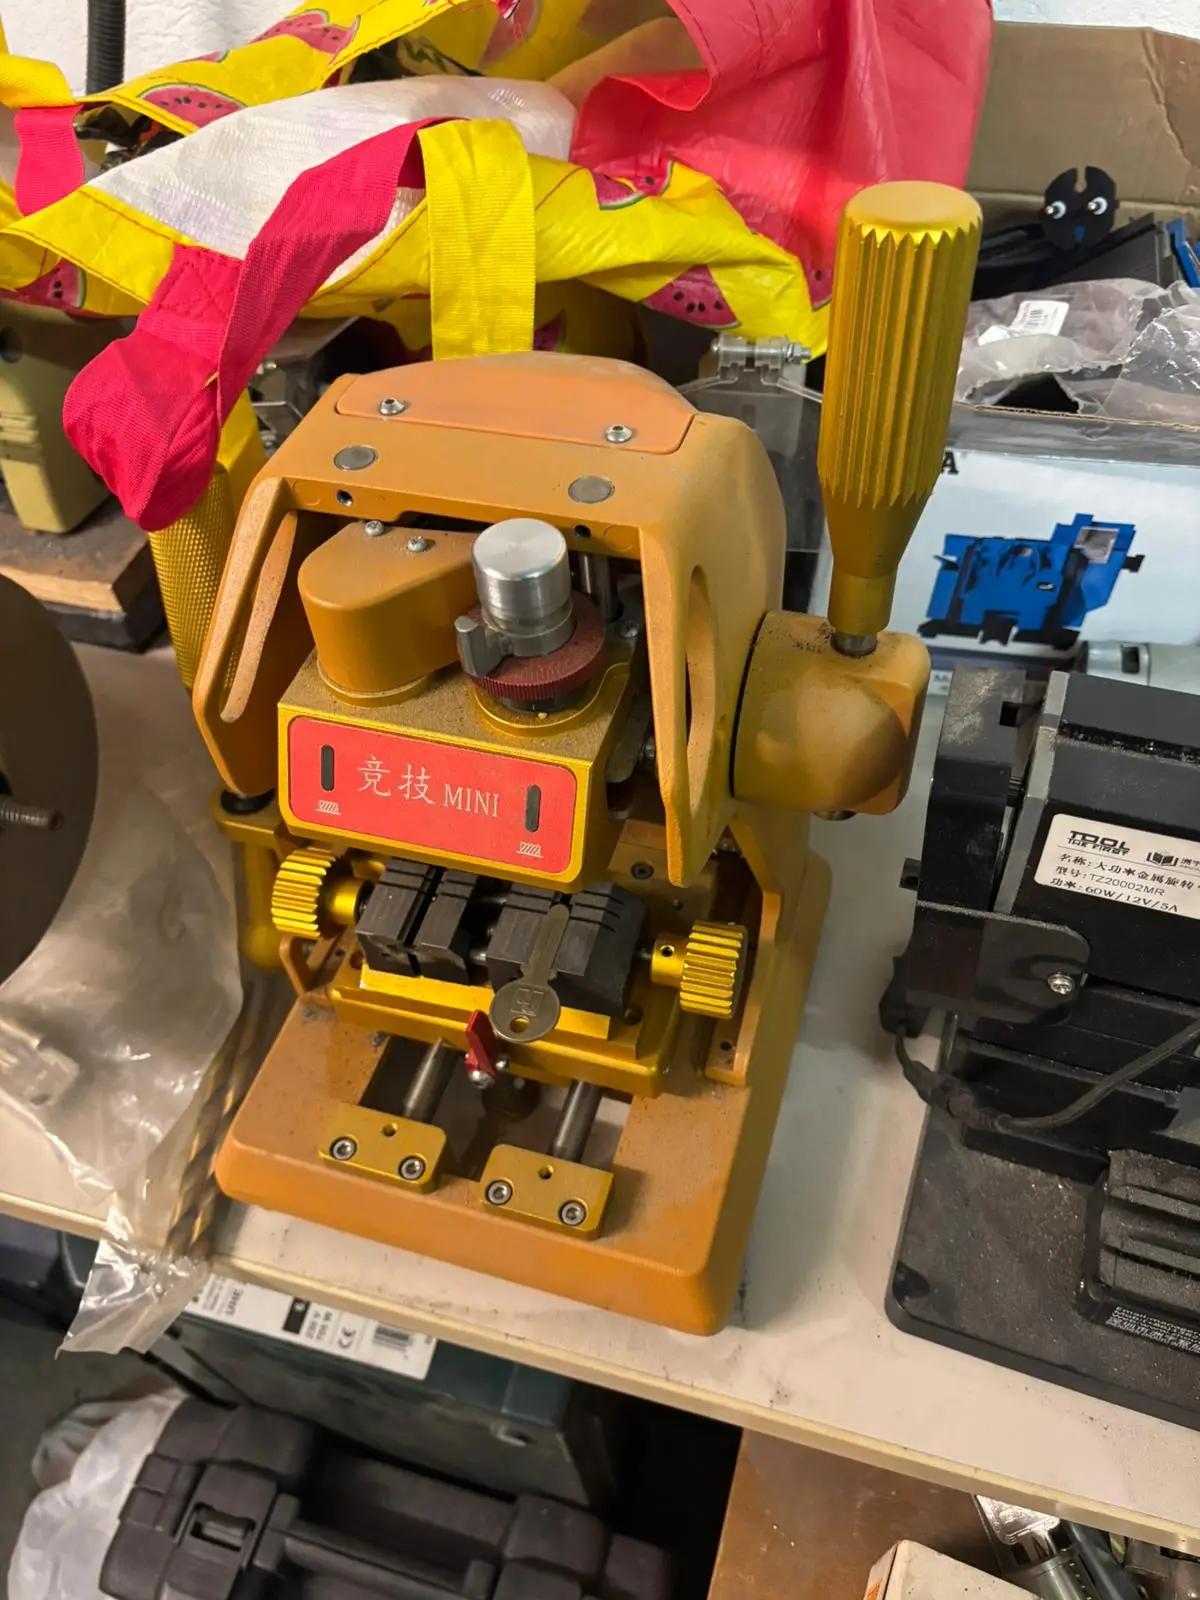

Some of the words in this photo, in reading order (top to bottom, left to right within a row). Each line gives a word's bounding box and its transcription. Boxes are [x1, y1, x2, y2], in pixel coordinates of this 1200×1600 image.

[357, 754, 436, 805] 竞技
[443, 783, 500, 818] MINI
[1069, 829, 1131, 851] TOOL
